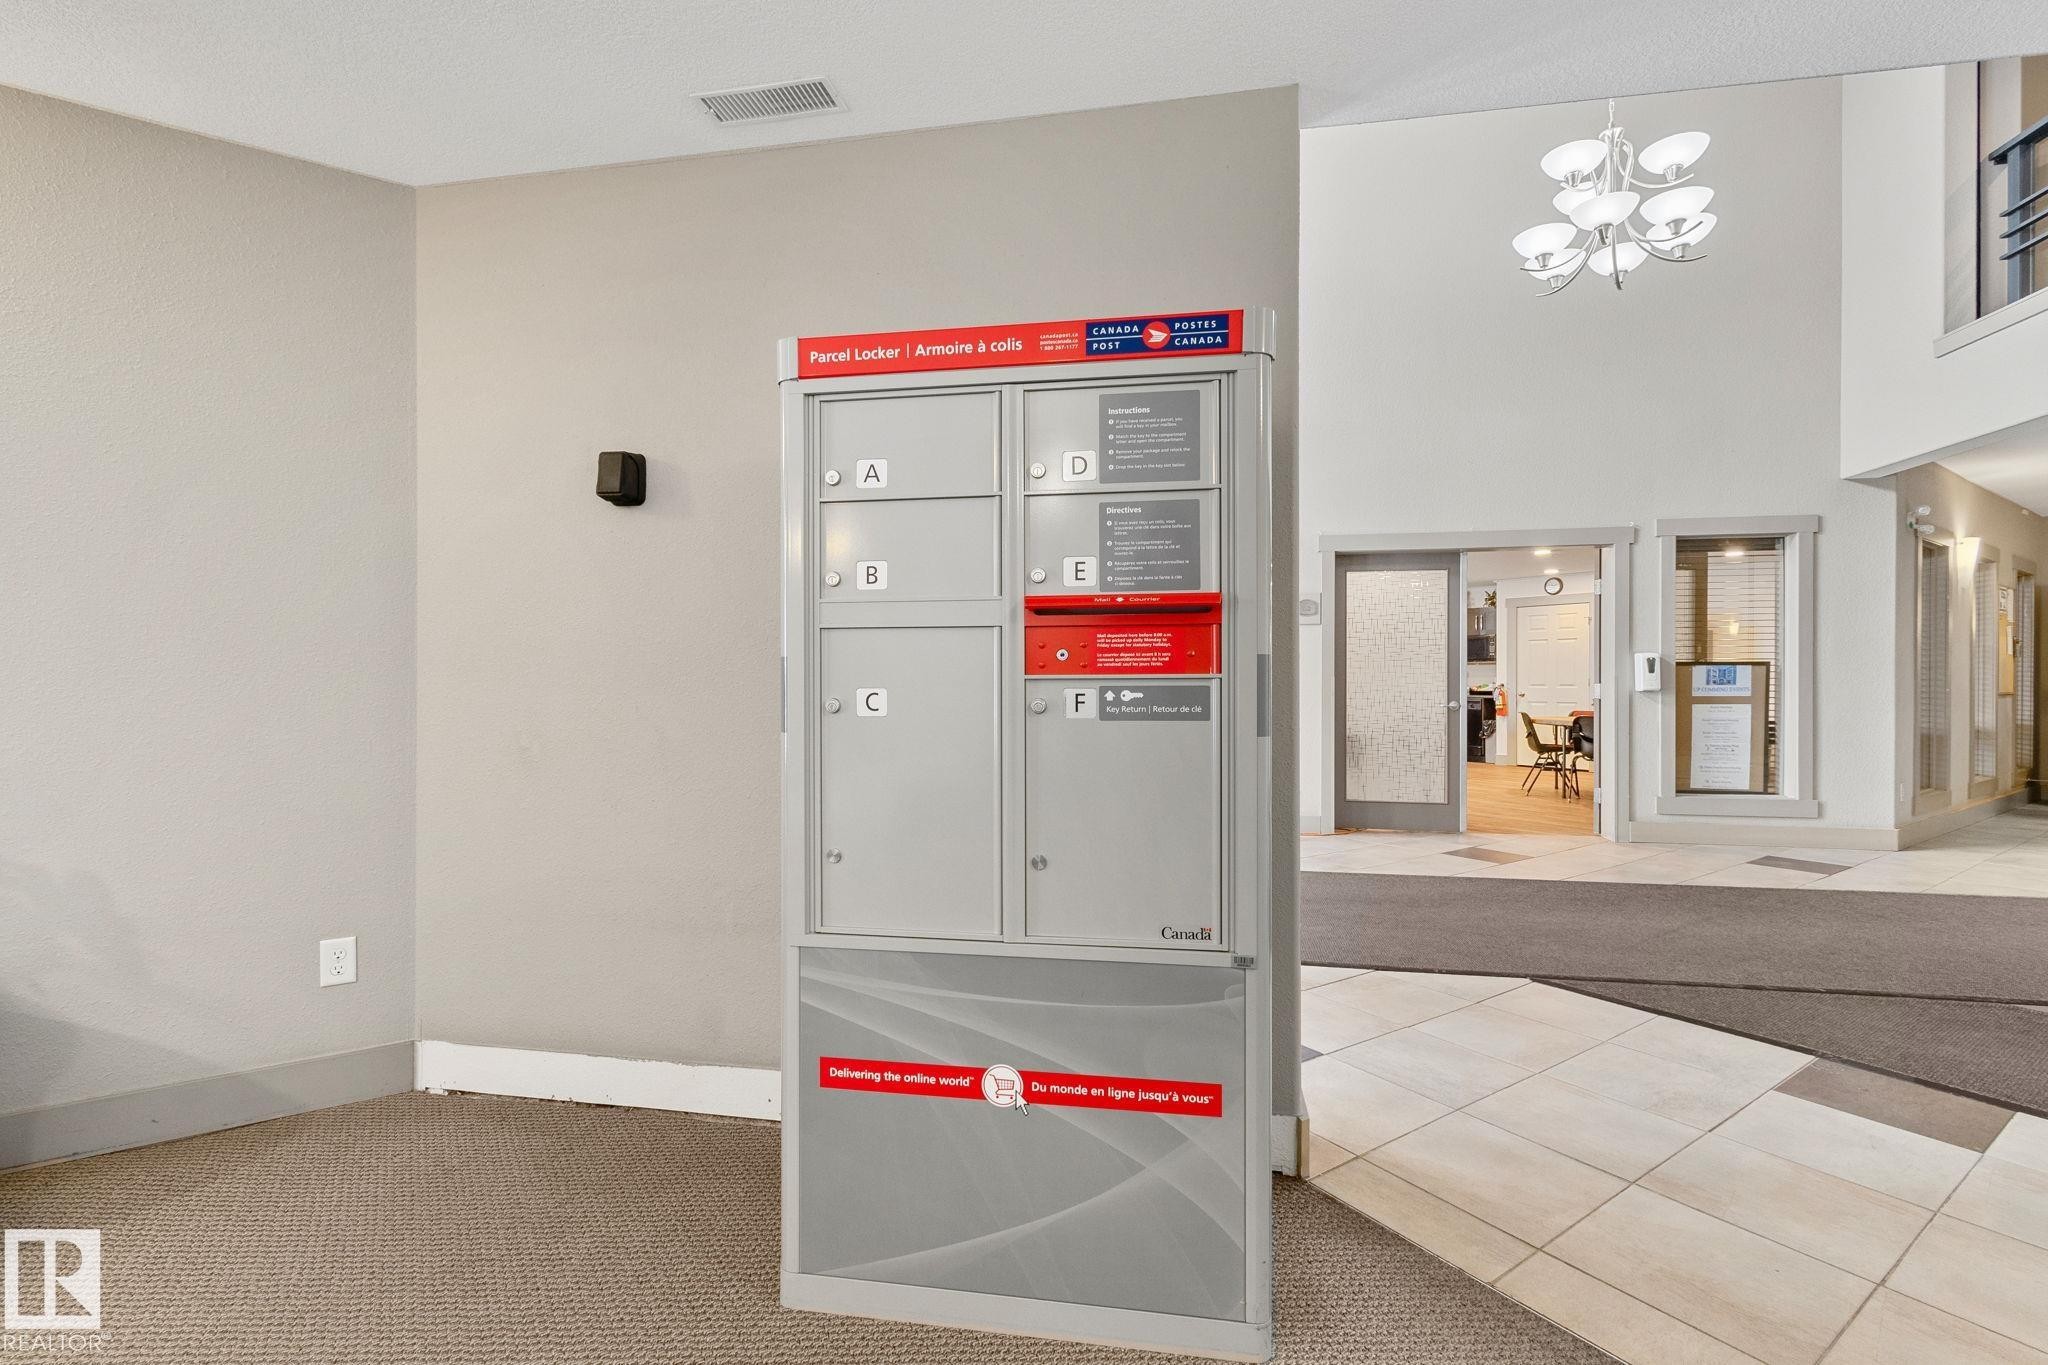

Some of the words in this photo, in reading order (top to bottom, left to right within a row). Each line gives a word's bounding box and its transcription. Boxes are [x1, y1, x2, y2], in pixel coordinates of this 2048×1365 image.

[1092, 325, 1140, 336] CANADA
[1174, 320, 1217, 331] POSTES
[1092, 342, 1121, 351] POST
[1174, 336, 1222, 346] CANADA
[810, 348, 850, 364] Parcel
[854, 347, 900, 362] Locker
[914, 341, 974, 357] Armoire
[978, 340, 986, 353] à
[990, 338, 1022, 352] colis
[864, 464, 880, 483] A
[1072, 456, 1088, 475] D
[866, 566, 878, 584] B
[1074, 562, 1086, 581] E
[866, 692, 879, 712] C
[1075, 694, 1086, 712] F
[1106, 706, 1120, 714] Key
[1161, 926, 1212, 940] Canada
[829, 1067, 881, 1083] Delivering
[884, 1072, 900, 1082] the
[904, 1074, 936, 1084] online
[1031, 1082, 1047, 1092] Du
[1050, 1084, 1088, 1095] monde
[1090, 1088, 1105, 1096] en
[1108, 1086, 1135, 1100] ligne
[1138, 1089, 1179, 1102] jusqu'à
